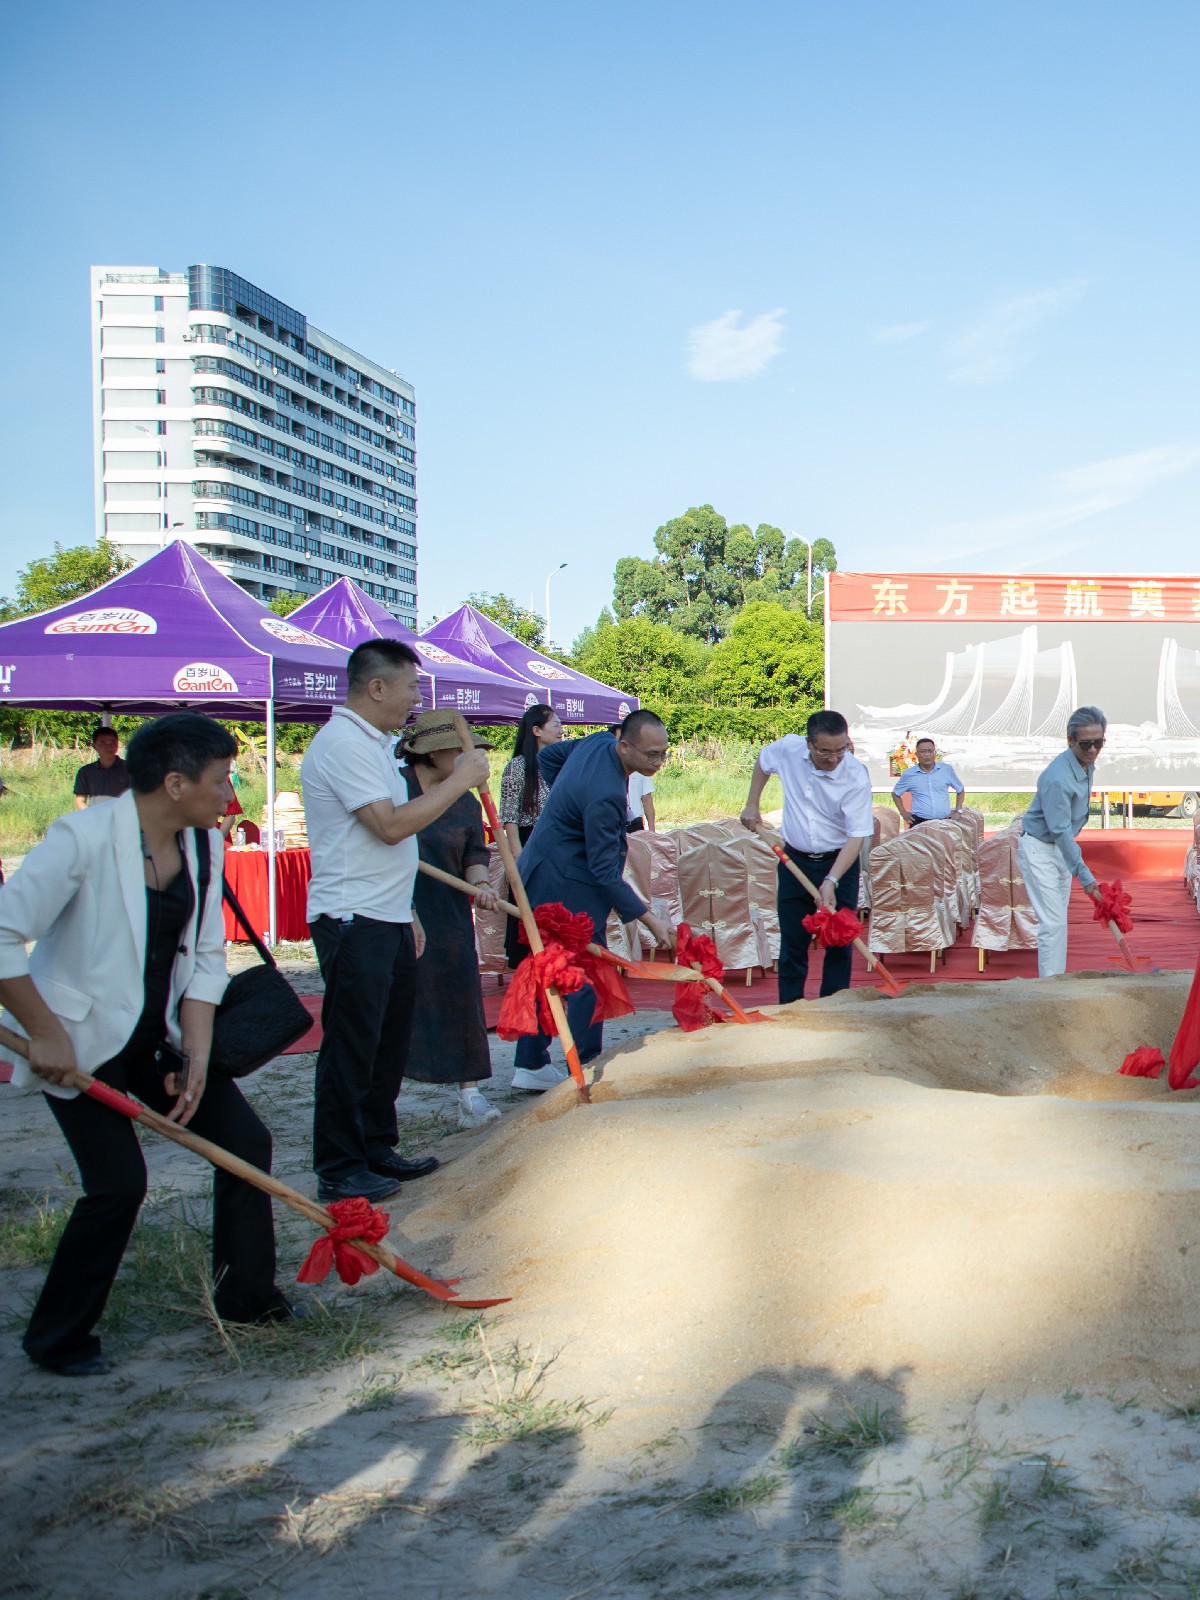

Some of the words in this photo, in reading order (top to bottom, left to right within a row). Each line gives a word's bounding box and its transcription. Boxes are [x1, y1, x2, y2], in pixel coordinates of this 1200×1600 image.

[78, 612, 139, 621] 百岁山
[186, 668, 220, 677] 百岁山
[304, 672, 336, 691] 百岁山
[457, 688, 480, 704] 百岁山
[565, 699, 584, 712] 百岁山
